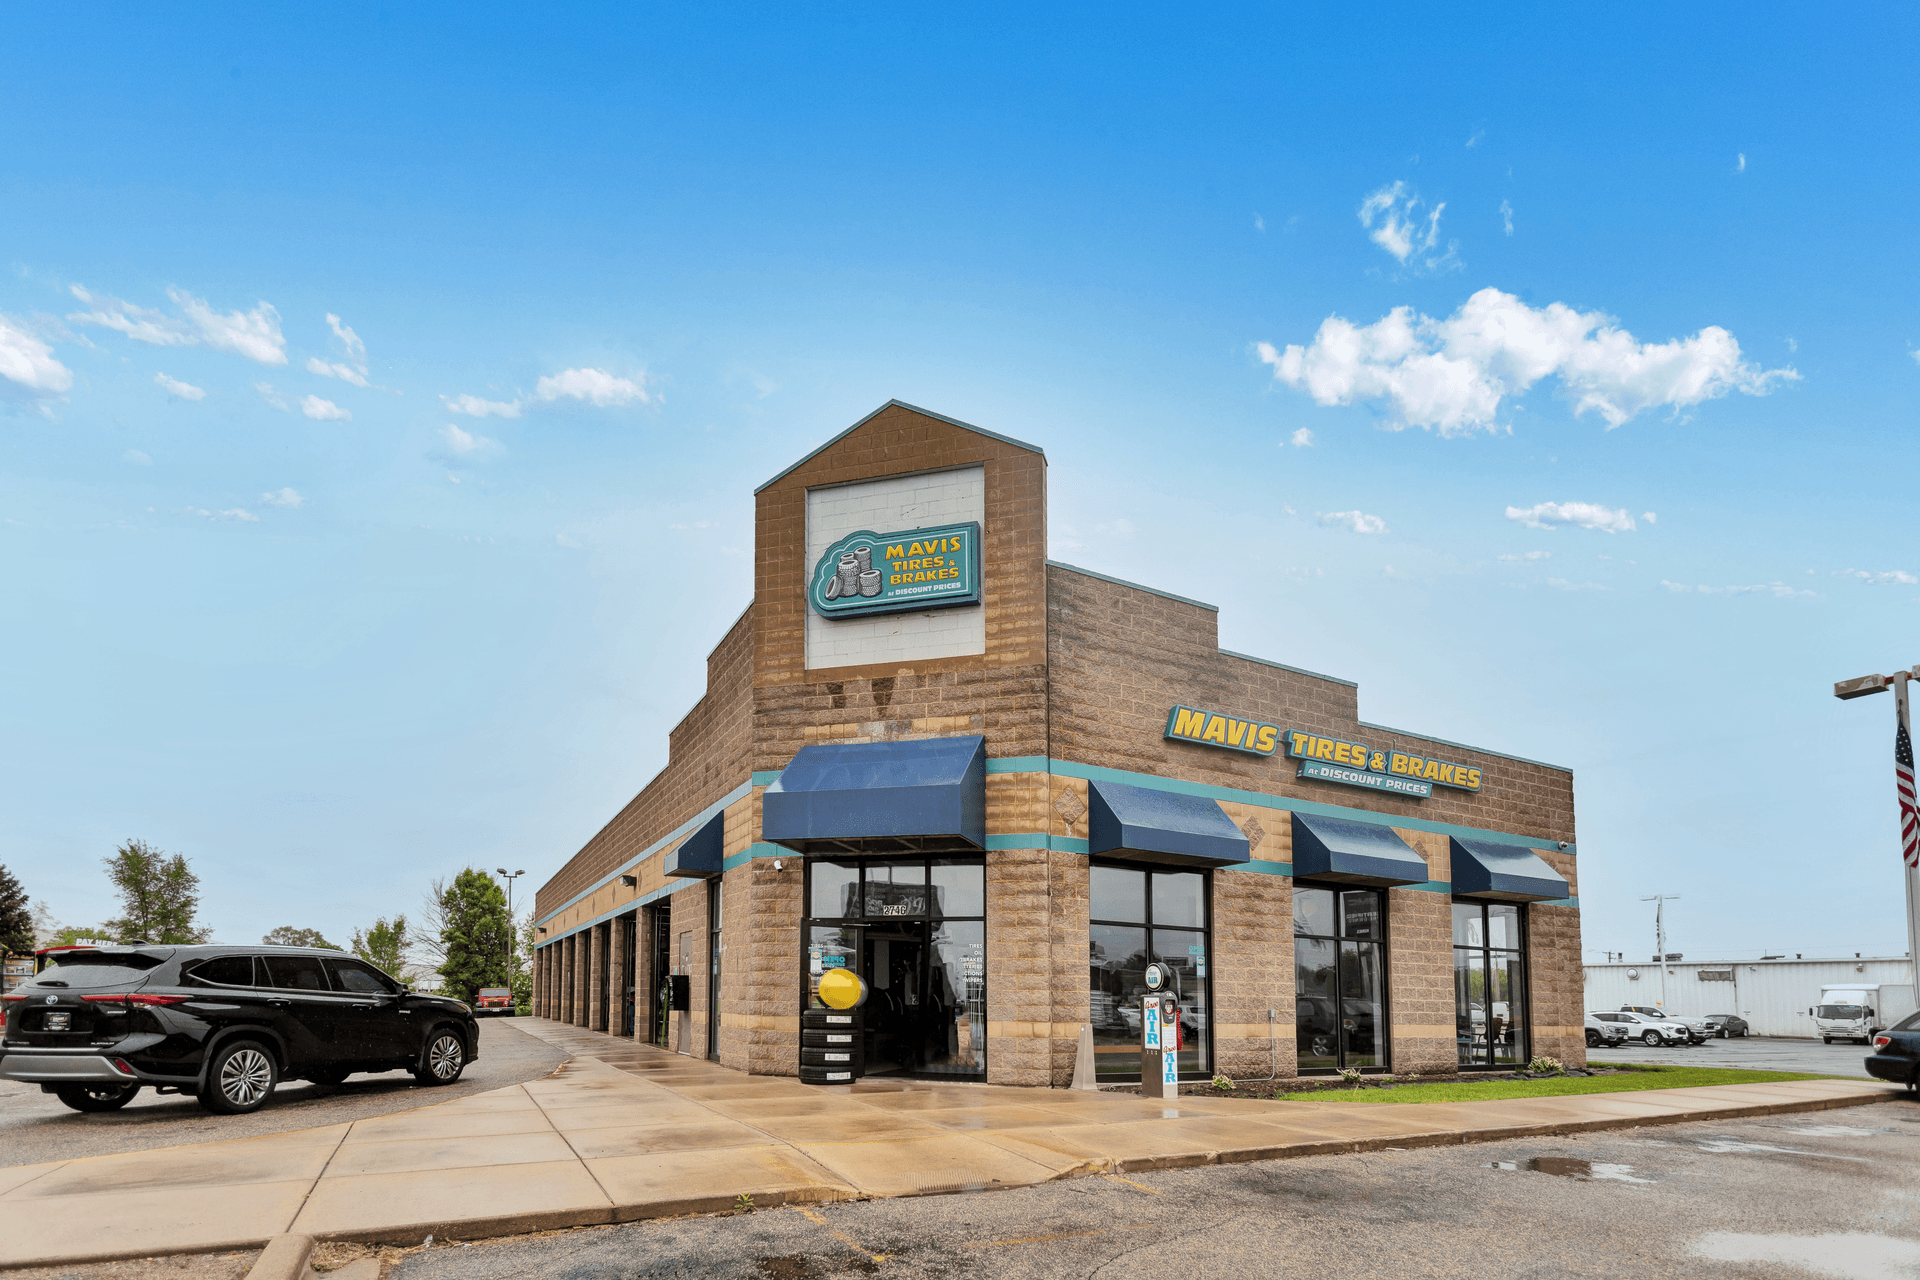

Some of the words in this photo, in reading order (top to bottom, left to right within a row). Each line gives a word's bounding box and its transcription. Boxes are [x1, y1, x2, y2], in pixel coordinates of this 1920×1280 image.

[885, 536, 961, 560] MAVIS
[889, 567, 959, 586] BRAKES
[892, 556, 944, 573] TIRES
[948, 559, 956, 567] &
[895, 585, 932, 596] DISCOUNT
[933, 581, 961, 591] PRICES
[1173, 708, 1278, 752] MAVIS
[1292, 732, 1367, 767] TIRES
[1370, 751, 1386, 771] &
[1391, 753, 1482, 790] BRAKES
[1307, 768, 1319, 776] At
[1319, 767, 1383, 787] DISCOUNT
[1385, 779, 1428, 795] PRICES
[76, 938, 94, 946] PAY
[1148, 976, 1158, 984] AIR
[1146, 1009, 1159, 1045] AIR
[1165, 1053, 1176, 1083] AIR
